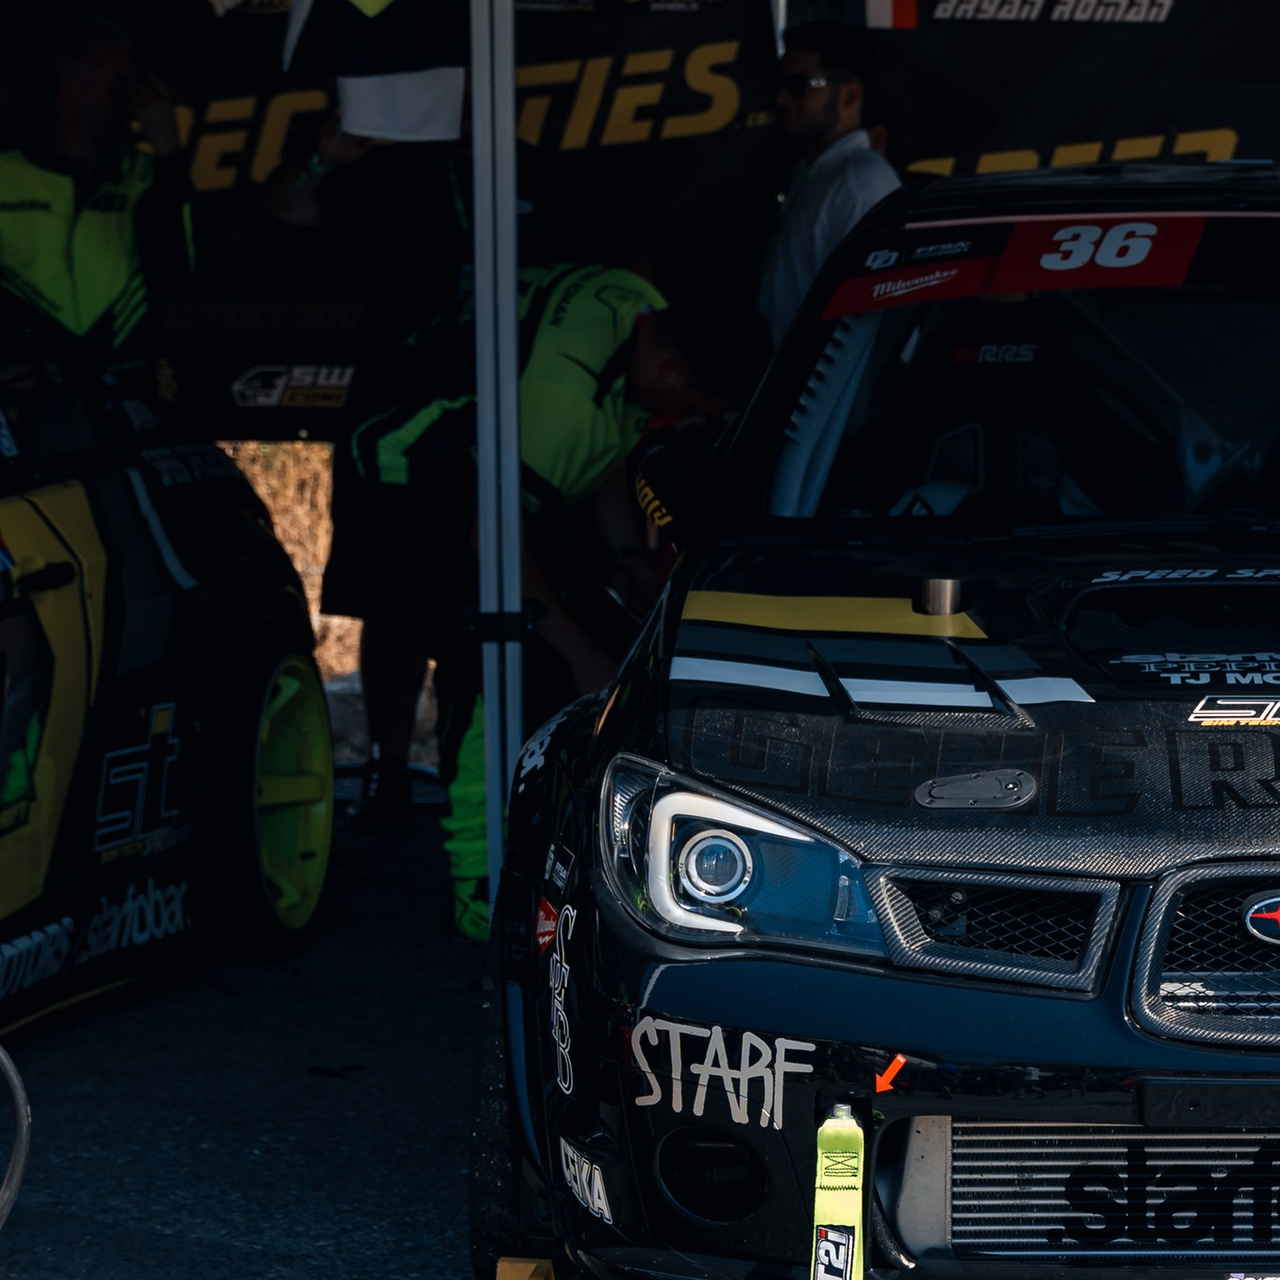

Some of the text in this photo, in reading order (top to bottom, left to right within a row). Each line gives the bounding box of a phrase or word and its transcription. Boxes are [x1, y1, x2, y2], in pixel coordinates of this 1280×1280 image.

[1039, 222, 1159, 272] 36
[871, 268, 960, 299] Milwaukee
[1091, 570, 1219, 583] SPEED
[1160, 673, 1211, 685] TJ
[631, 1016, 816, 1130] STARF
